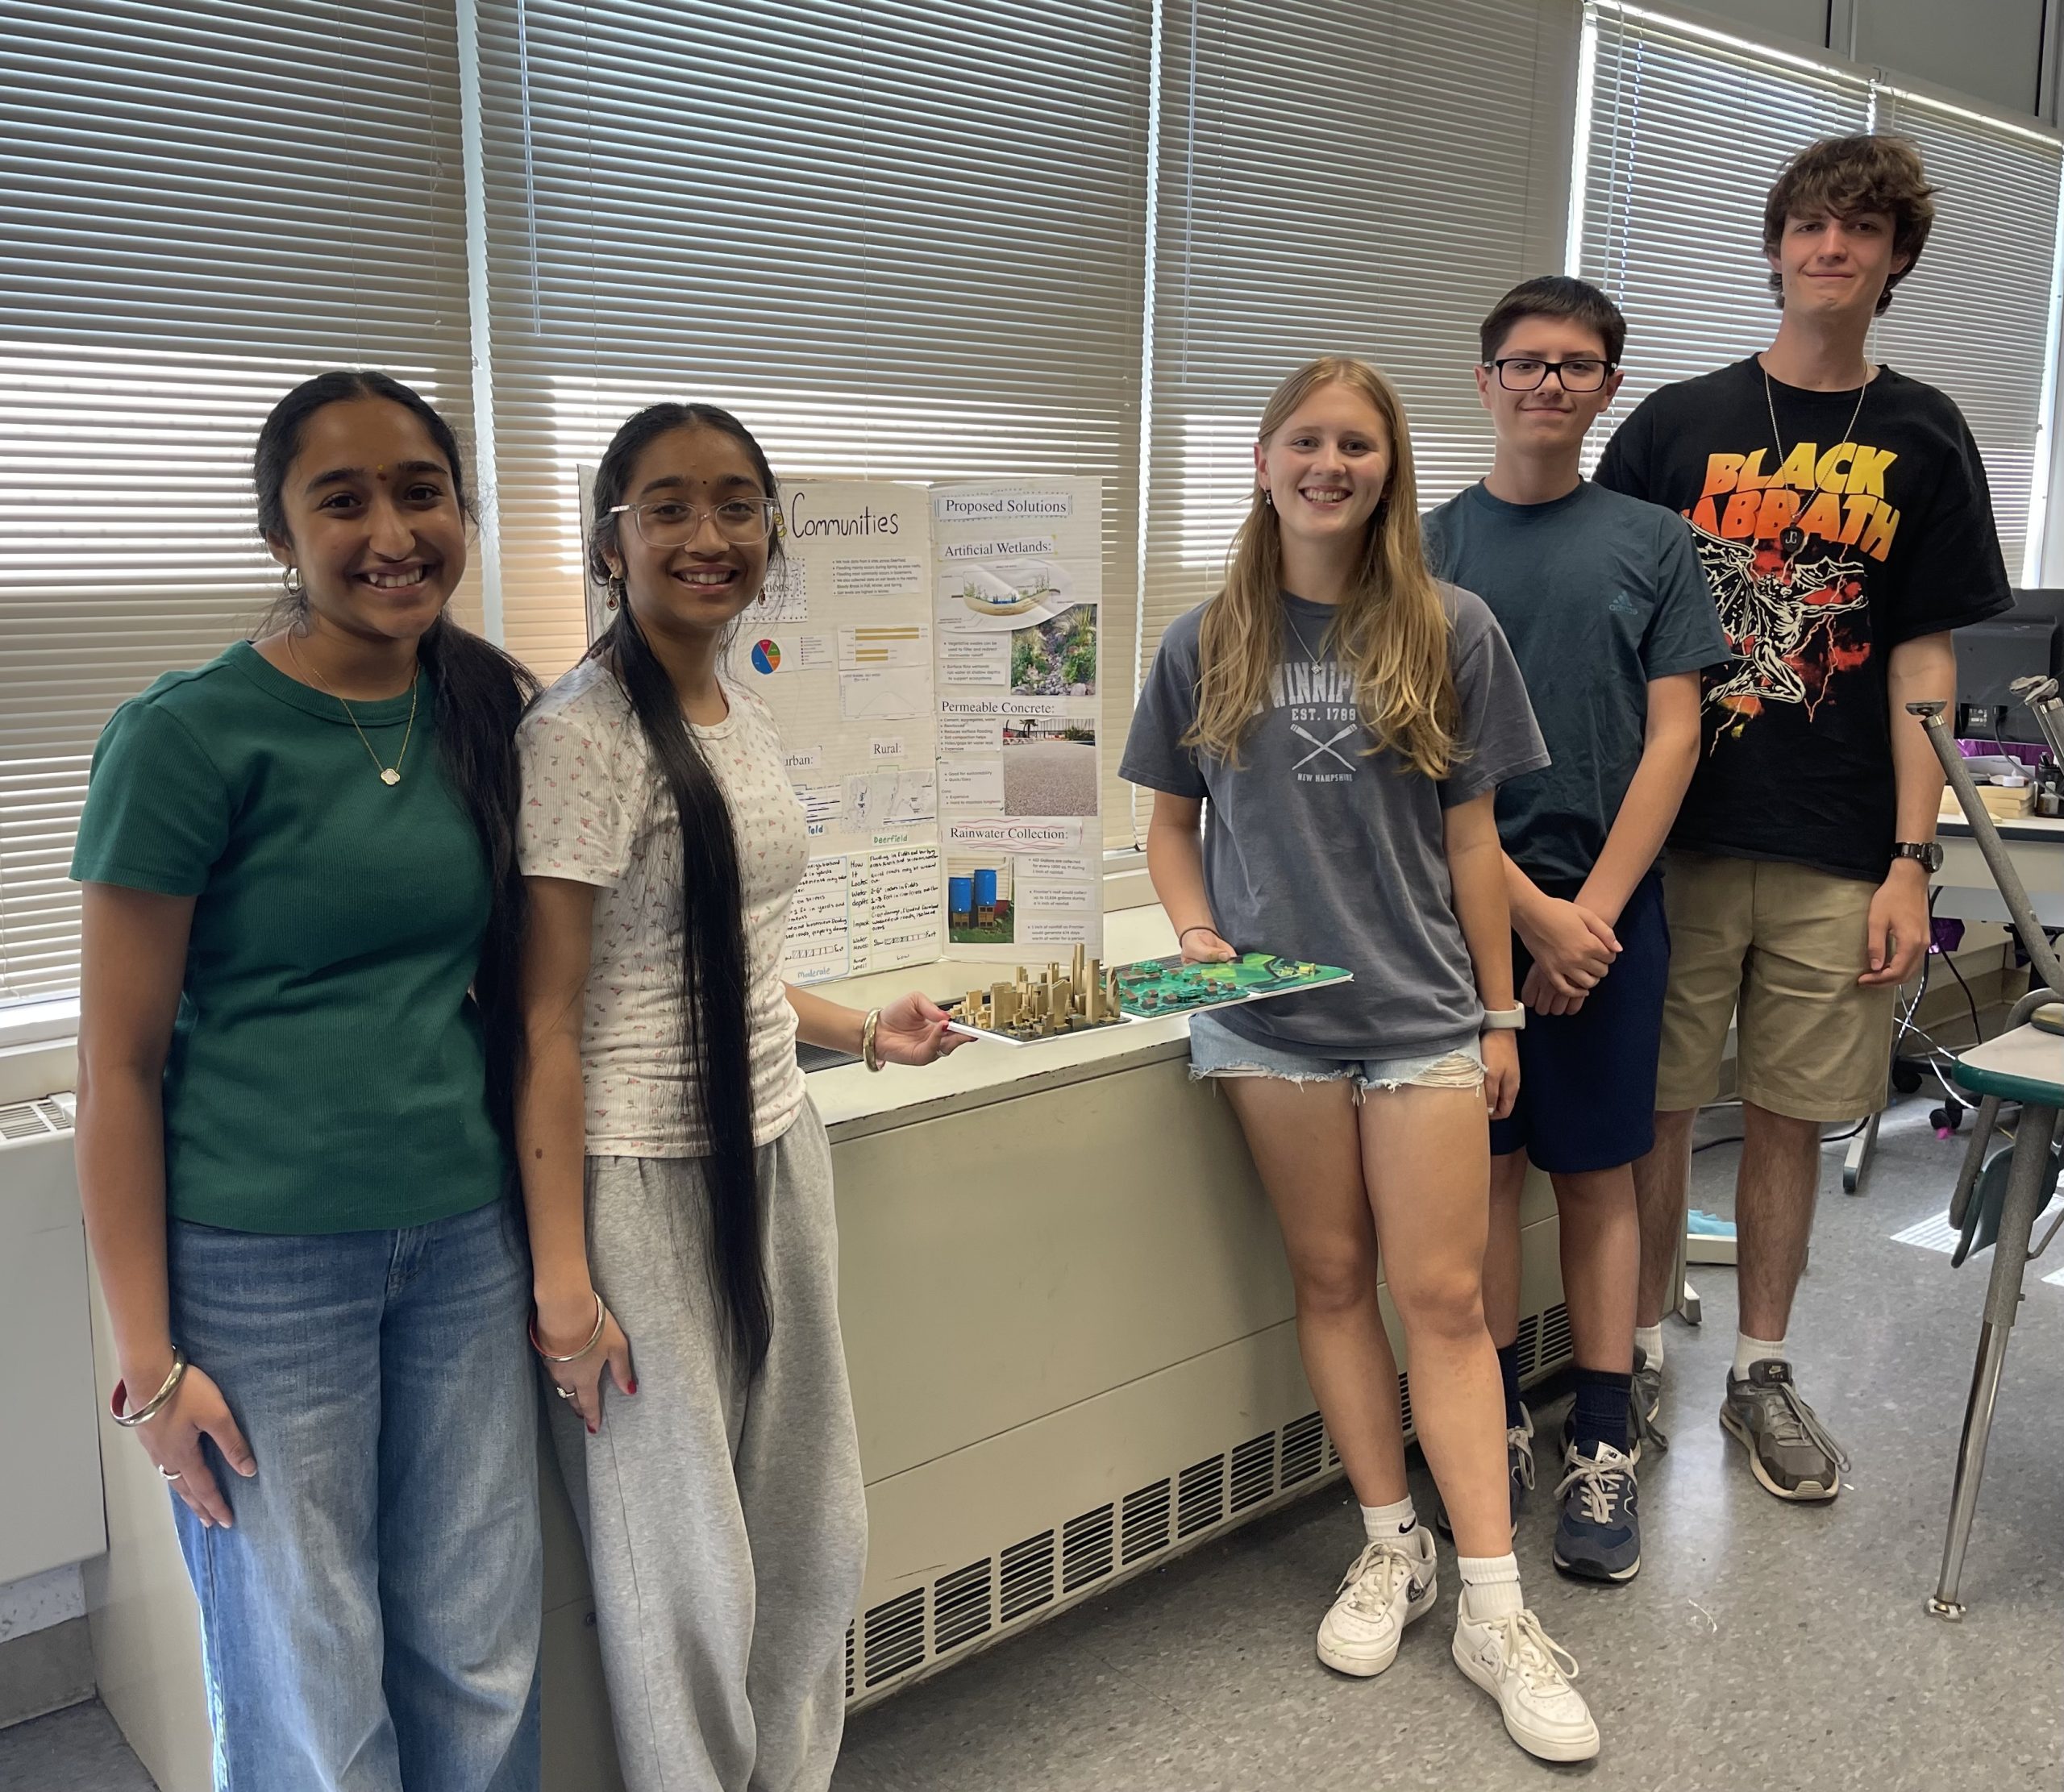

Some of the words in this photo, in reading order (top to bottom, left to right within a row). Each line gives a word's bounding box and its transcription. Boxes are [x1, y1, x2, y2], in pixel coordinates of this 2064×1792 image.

[1701, 443, 1898, 499] BLACK
[946, 500, 1004, 515] Proposed
[1007, 498, 1067, 513] Solutions
[792, 493, 899, 538] Communities
[1680, 489, 1900, 563] ABBATH
[945, 543, 993, 557] Artificial
[997, 541, 1052, 554] Wetlands:
[1267, 662, 1361, 708] WINNIP
[942, 701, 998, 712] Permeable
[1001, 702, 1055, 715] Concrete:
[1292, 709, 1321, 721] EST.
[874, 743, 901, 755] Rural:
[1297, 773, 1313, 782] NEW
[1316, 773, 1352, 782] HAMPSHIRE
[874, 835, 908, 843] Deerfield
[950, 827, 1005, 839] Rainwater
[1008, 826, 1068, 840] Collection:
